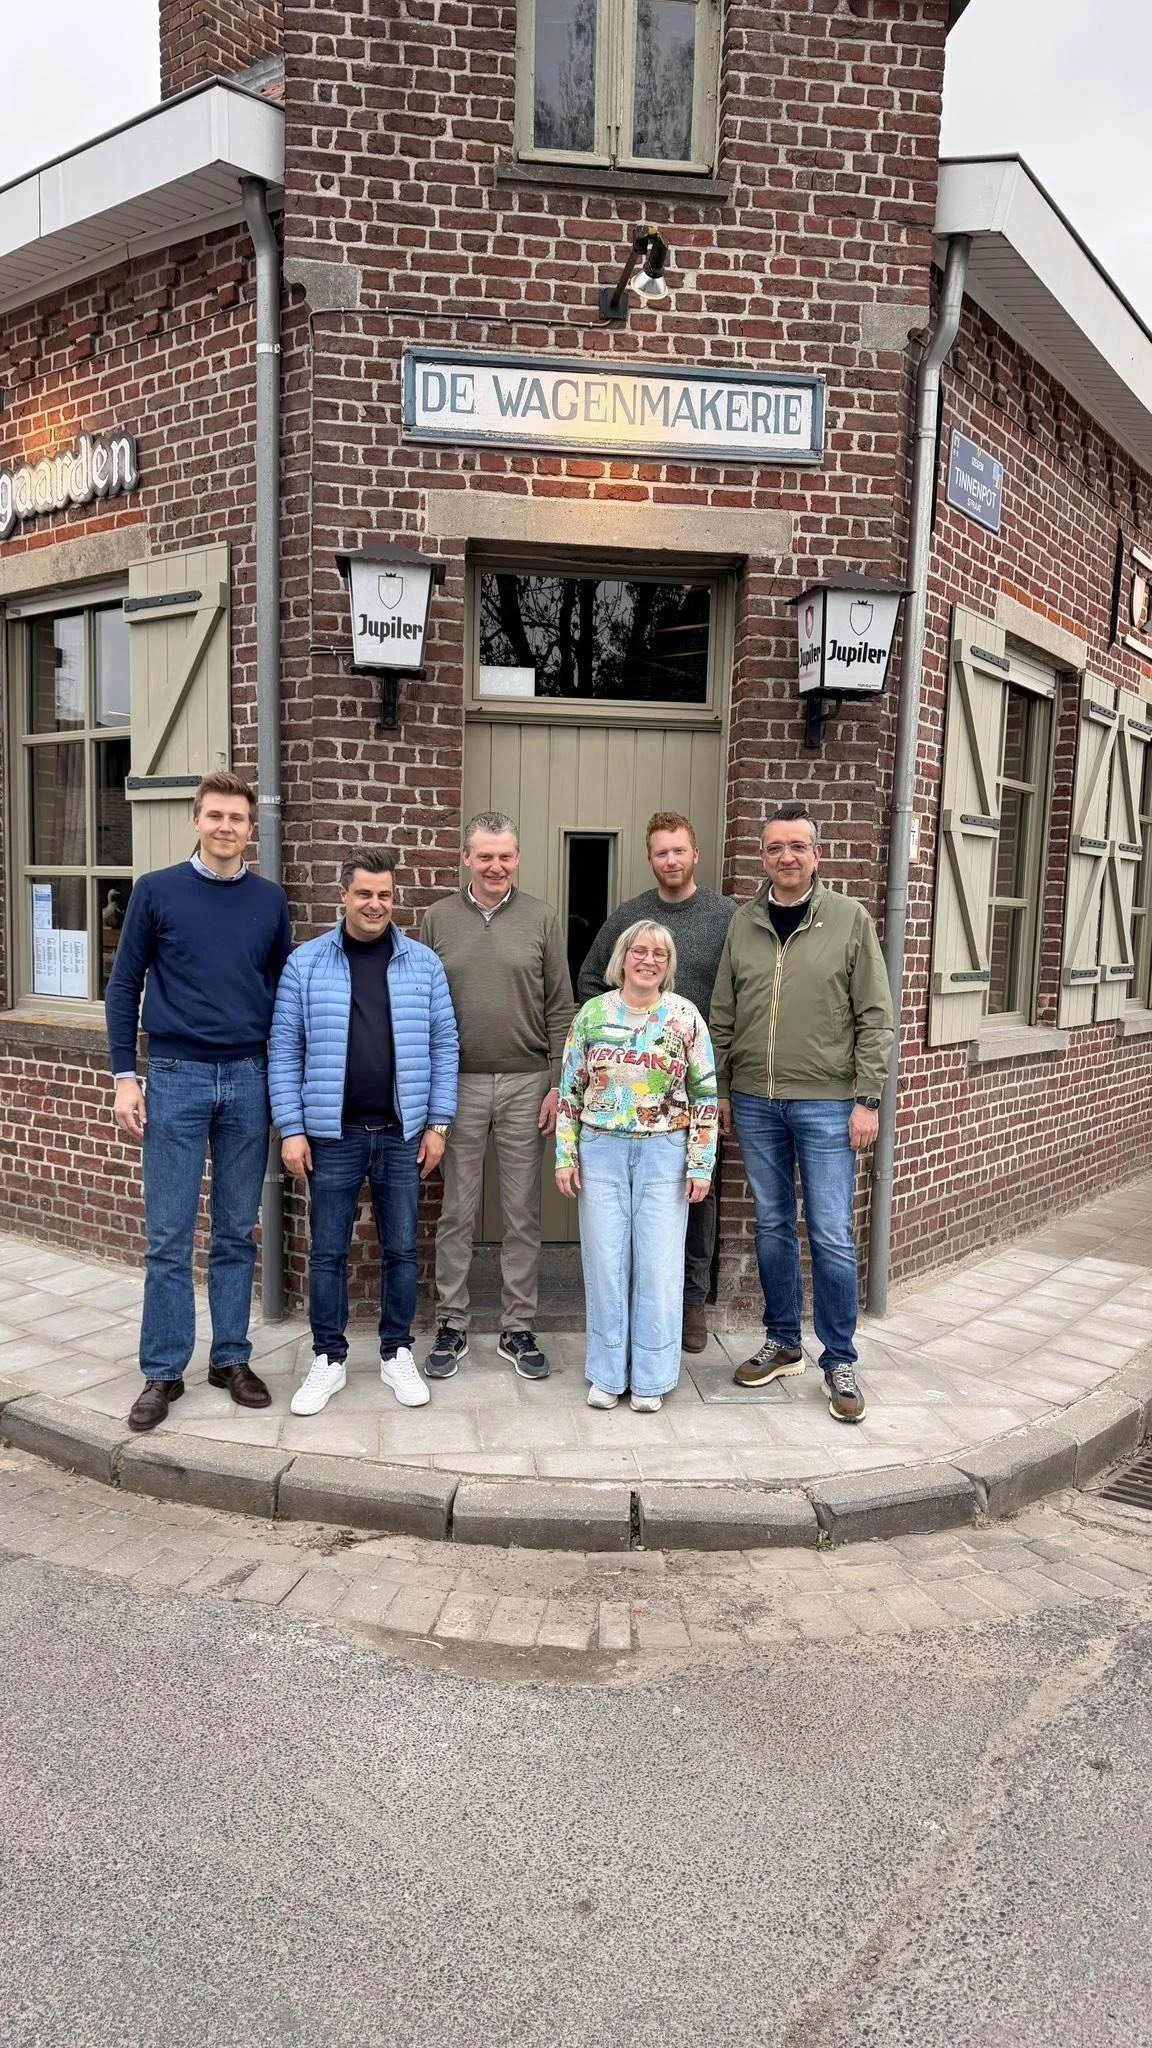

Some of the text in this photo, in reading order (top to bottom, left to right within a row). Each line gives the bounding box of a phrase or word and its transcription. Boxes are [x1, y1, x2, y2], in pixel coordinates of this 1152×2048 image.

[422, 371, 802, 435] DE WAGENMAKERIE
[0, 435, 133, 534] gaarden
[955, 466, 996, 509] TINNENPOT
[357, 613, 423, 644] Jupiler
[827, 639, 887, 668] Jupiler
